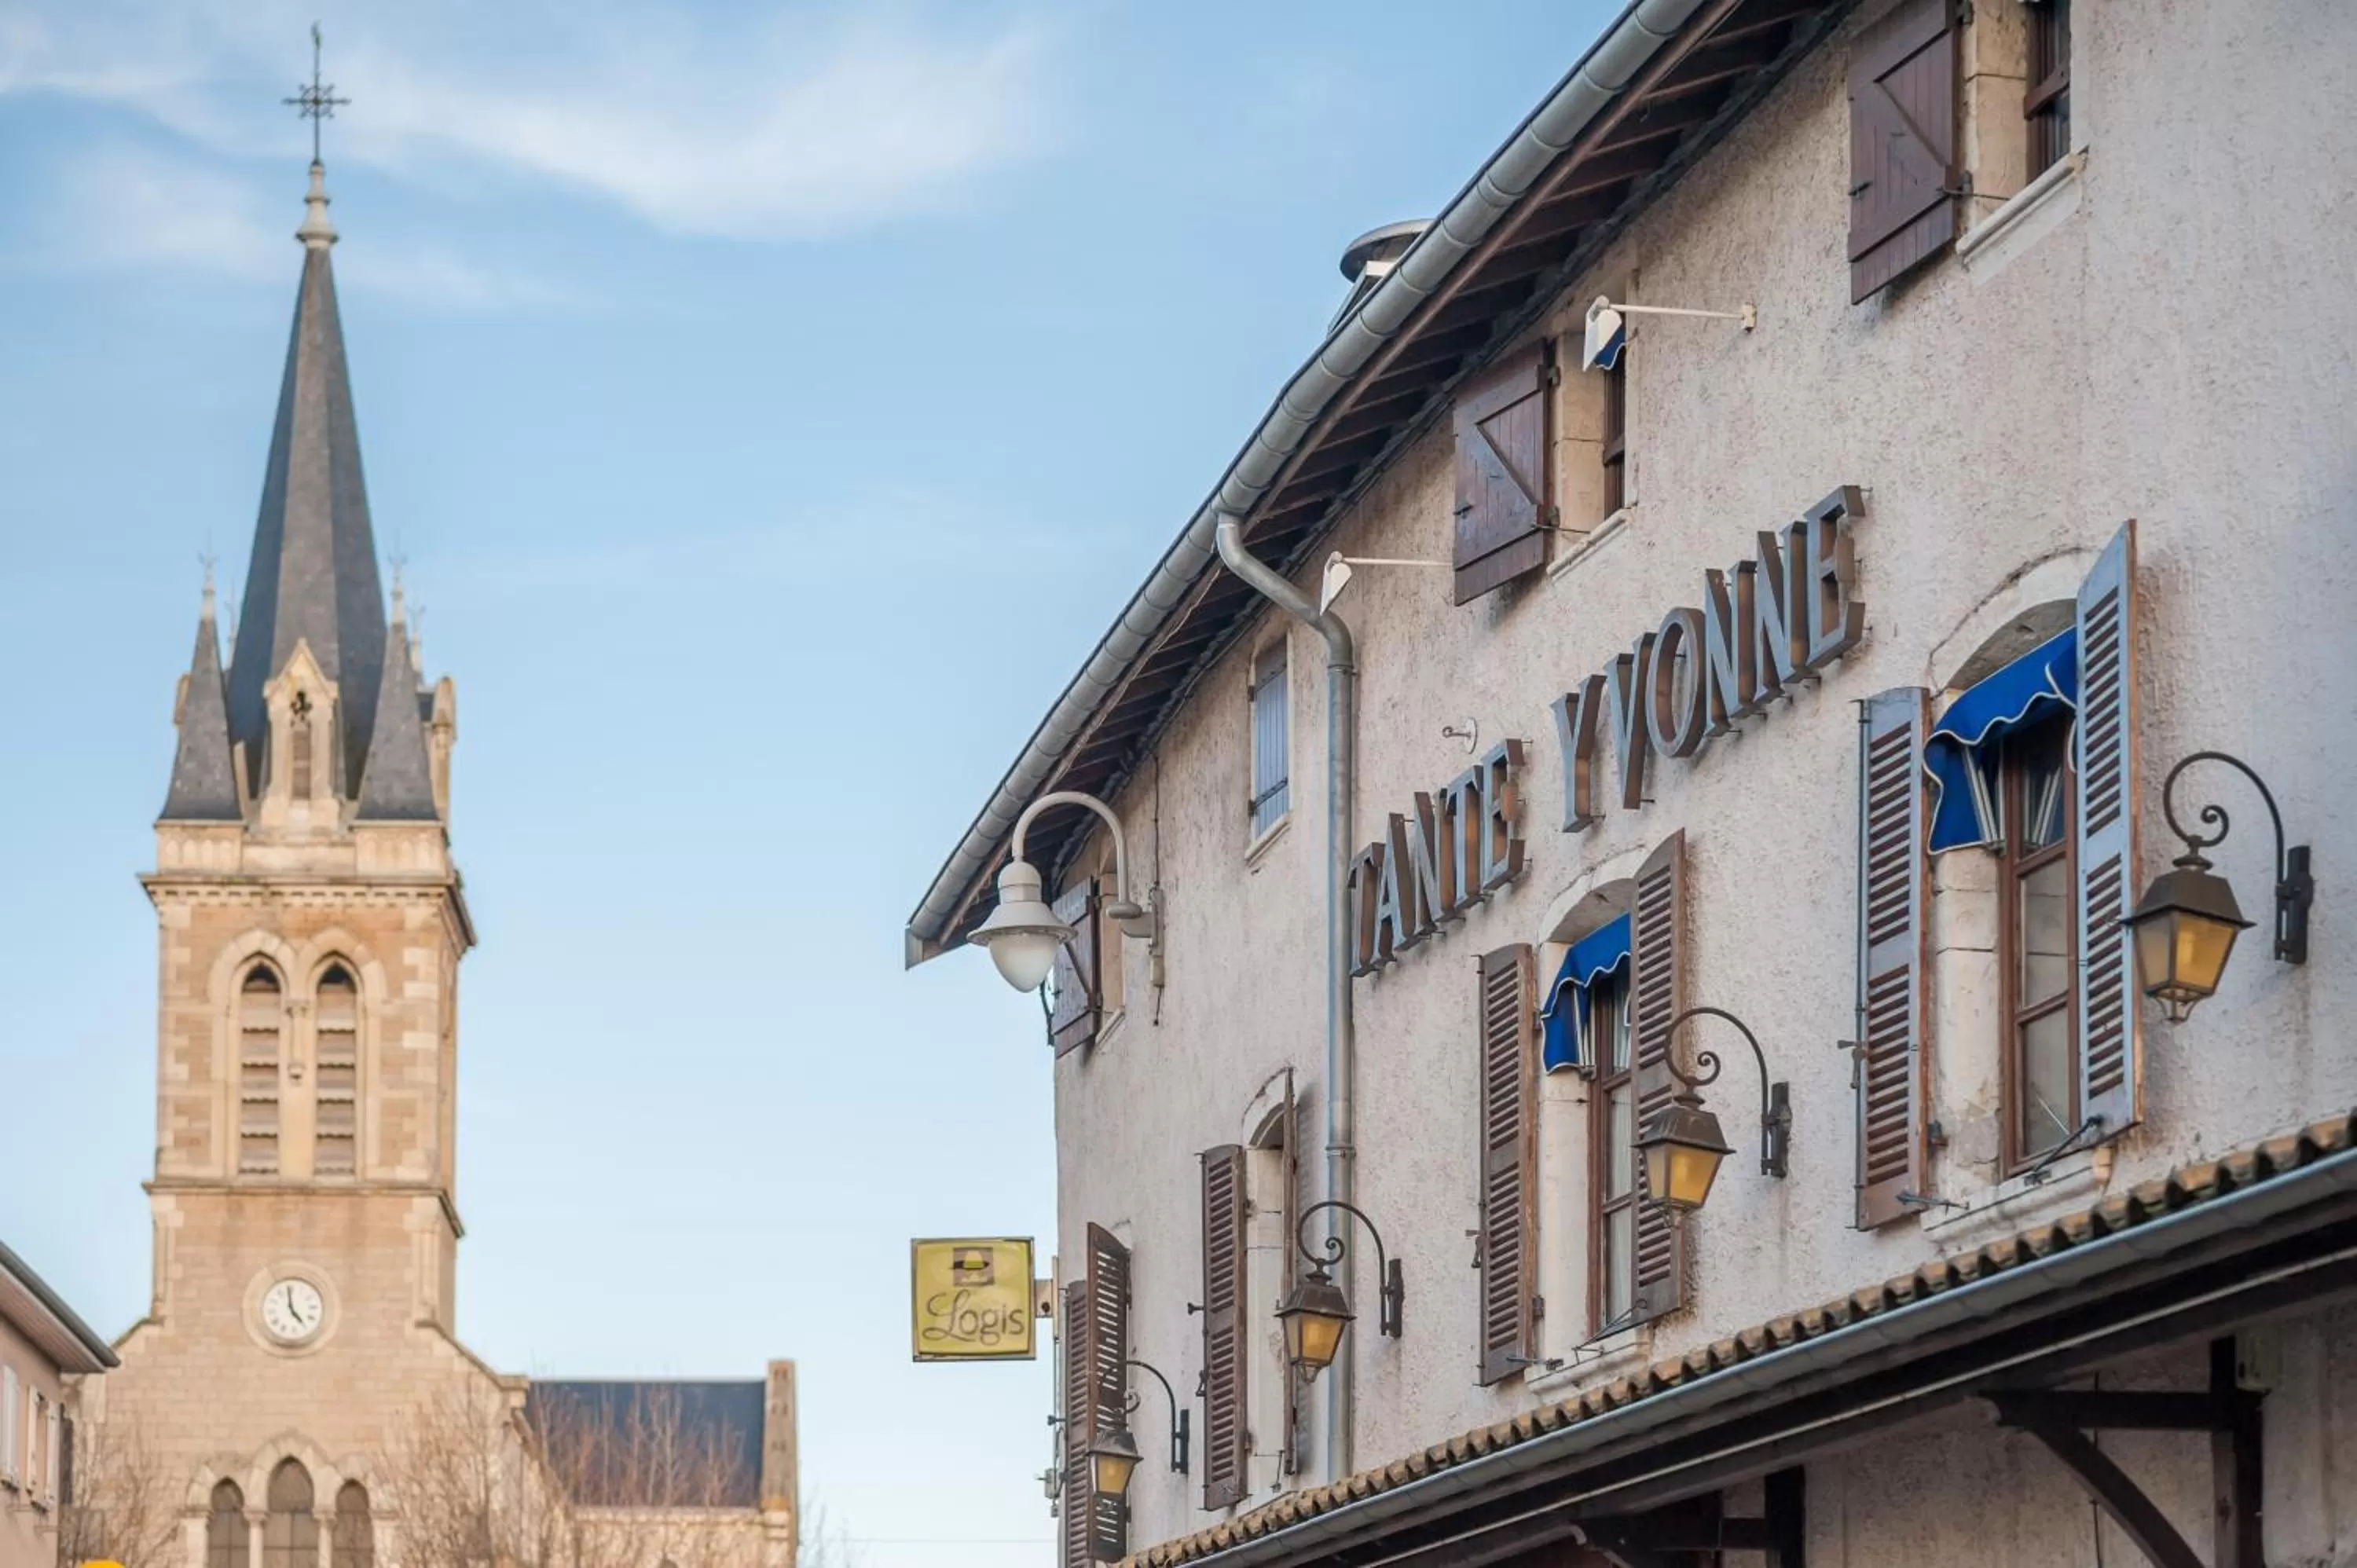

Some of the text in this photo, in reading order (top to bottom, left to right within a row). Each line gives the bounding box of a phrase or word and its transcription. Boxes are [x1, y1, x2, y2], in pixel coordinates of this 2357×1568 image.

[1348, 485, 1865, 976] TANTE YVONNE
[922, 1289, 1025, 1345] Logis
